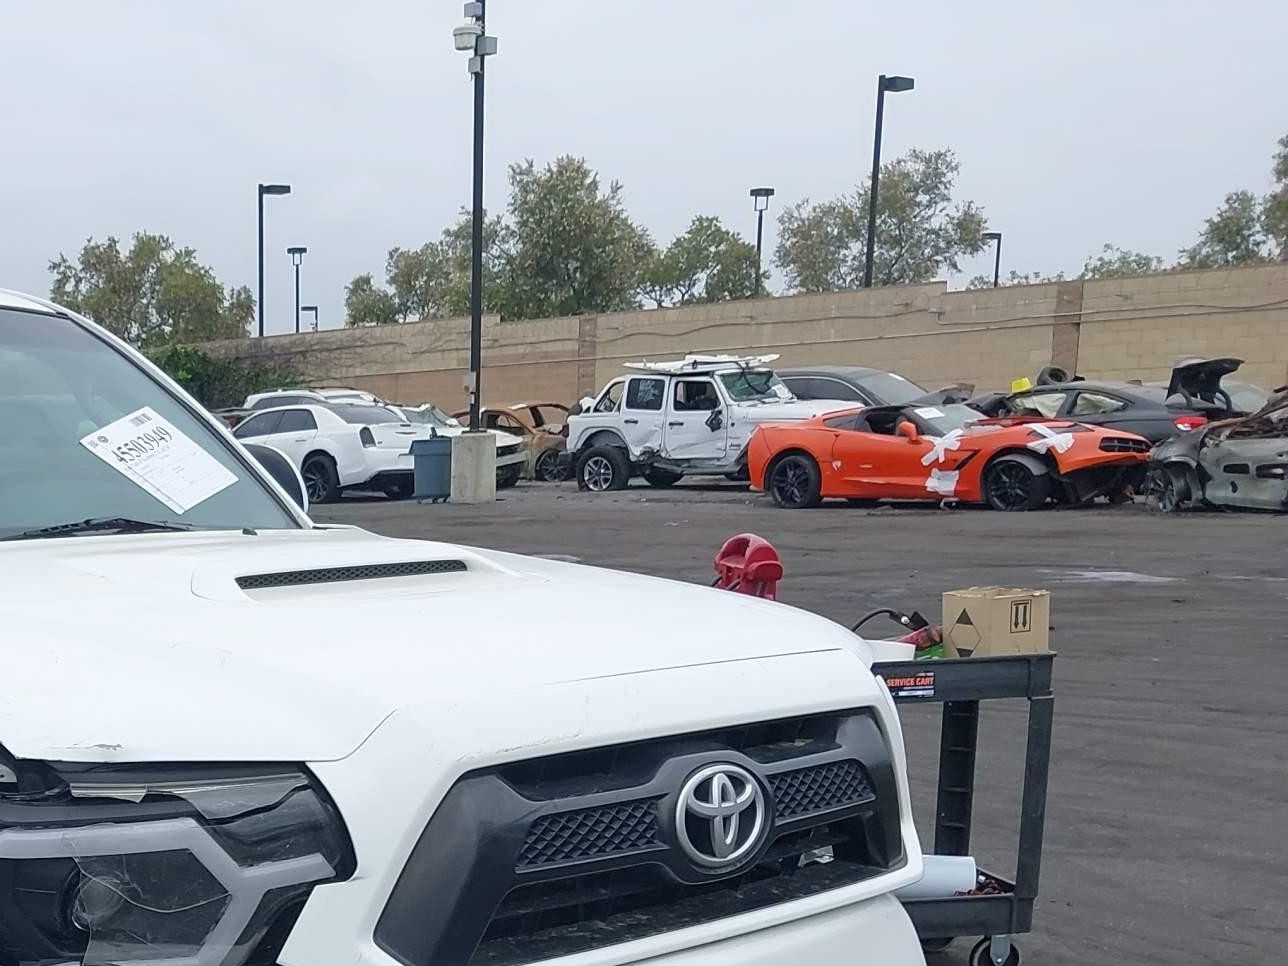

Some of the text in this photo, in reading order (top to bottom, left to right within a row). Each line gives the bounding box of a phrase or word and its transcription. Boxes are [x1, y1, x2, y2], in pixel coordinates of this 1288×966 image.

[112, 426, 172, 463] 45503949
[886, 677, 934, 686] SERVICE CART
